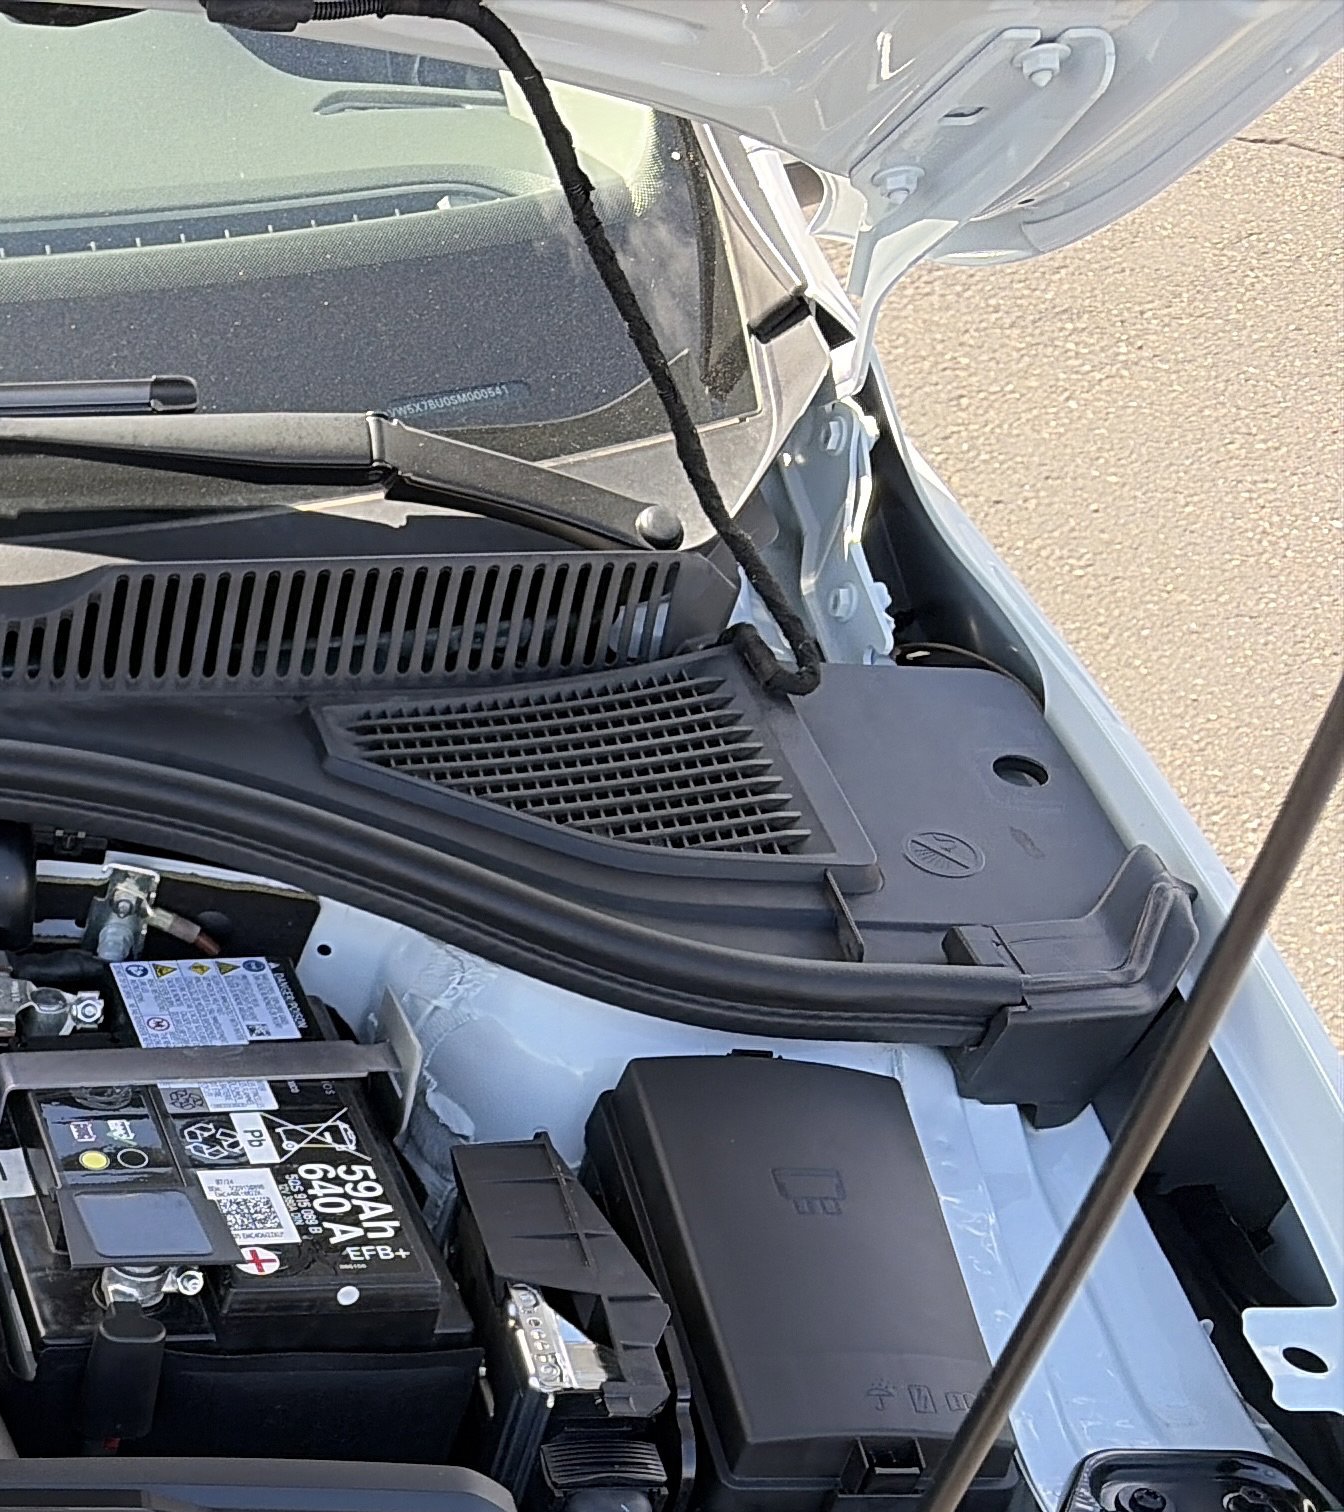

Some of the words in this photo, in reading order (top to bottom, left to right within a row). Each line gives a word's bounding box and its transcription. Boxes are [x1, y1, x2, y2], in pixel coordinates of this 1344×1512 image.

[243, 1128, 267, 1148] Pb
[297, 1163, 352, 1214] 640
[337, 1164, 401, 1239] 59Ah
[308, 1226, 323, 1235] B
[322, 1221, 365, 1244] A
